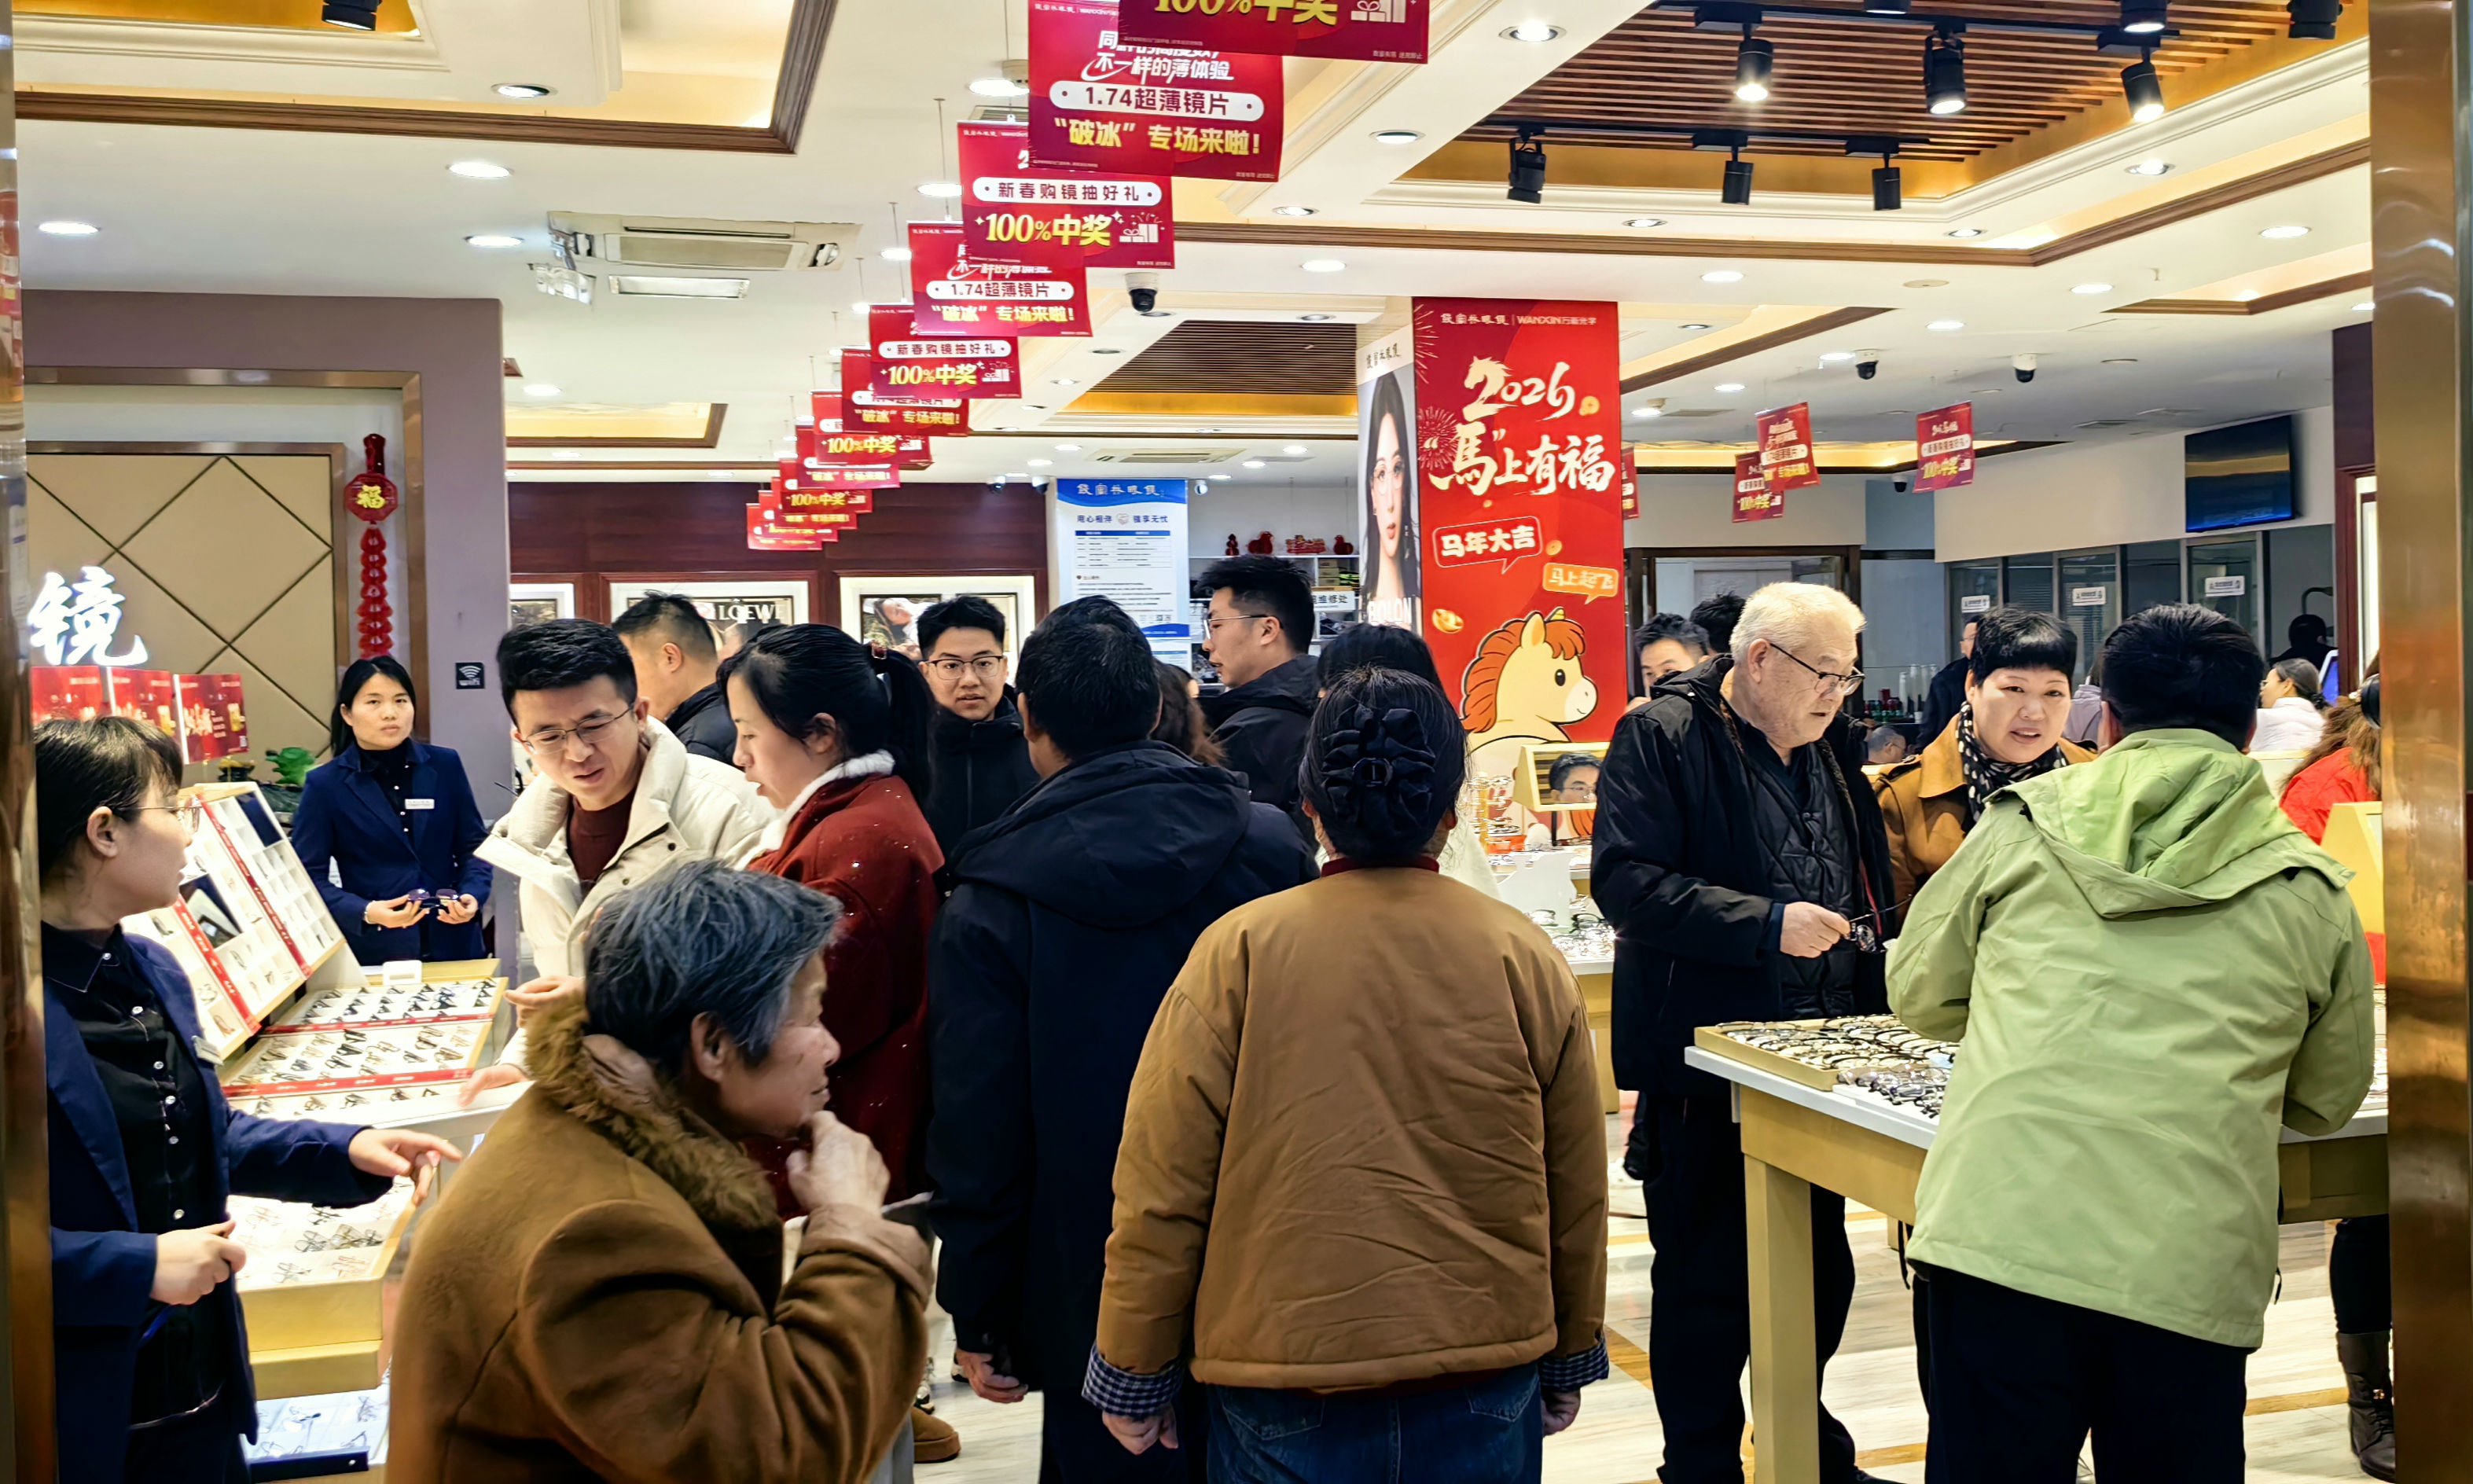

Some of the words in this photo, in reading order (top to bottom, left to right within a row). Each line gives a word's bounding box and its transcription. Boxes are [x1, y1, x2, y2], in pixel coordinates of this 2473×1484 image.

[1093, 52, 1235, 84] 不一样的薄体验
[1086, 87, 1229, 116] 1.74超薄镜片
[998, 182, 1139, 202] 新春购镜抽好礼
[986, 213, 1113, 246] 100%中奖
[952, 283, 1049, 297] 1.74超薄镜片
[888, 364, 977, 385] 100%中奖
[1462, 355, 1575, 422] 2026
[357, 484, 386, 509] 福
[1441, 525, 1536, 557] 马年大吉
[1548, 568, 1615, 590] 马上起飞
[28, 565, 149, 666] 镜
